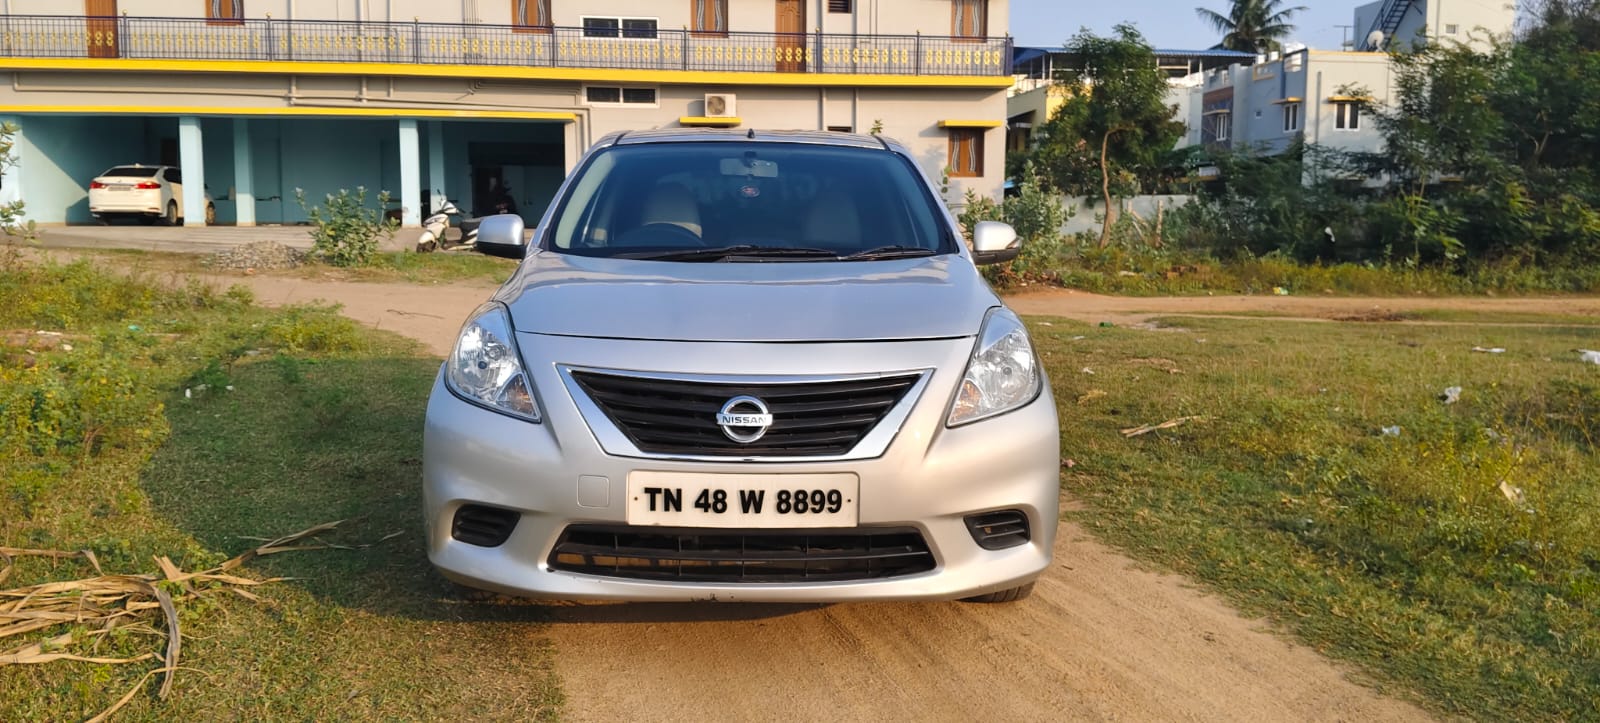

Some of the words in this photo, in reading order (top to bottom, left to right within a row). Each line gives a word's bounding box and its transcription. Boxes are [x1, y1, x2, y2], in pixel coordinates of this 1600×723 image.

[722, 415, 767, 424] NISSAN
[644, 487, 682, 512] TN
[694, 488, 728, 513] 48
[740, 489, 765, 514] W
[776, 489, 843, 514] 8899
